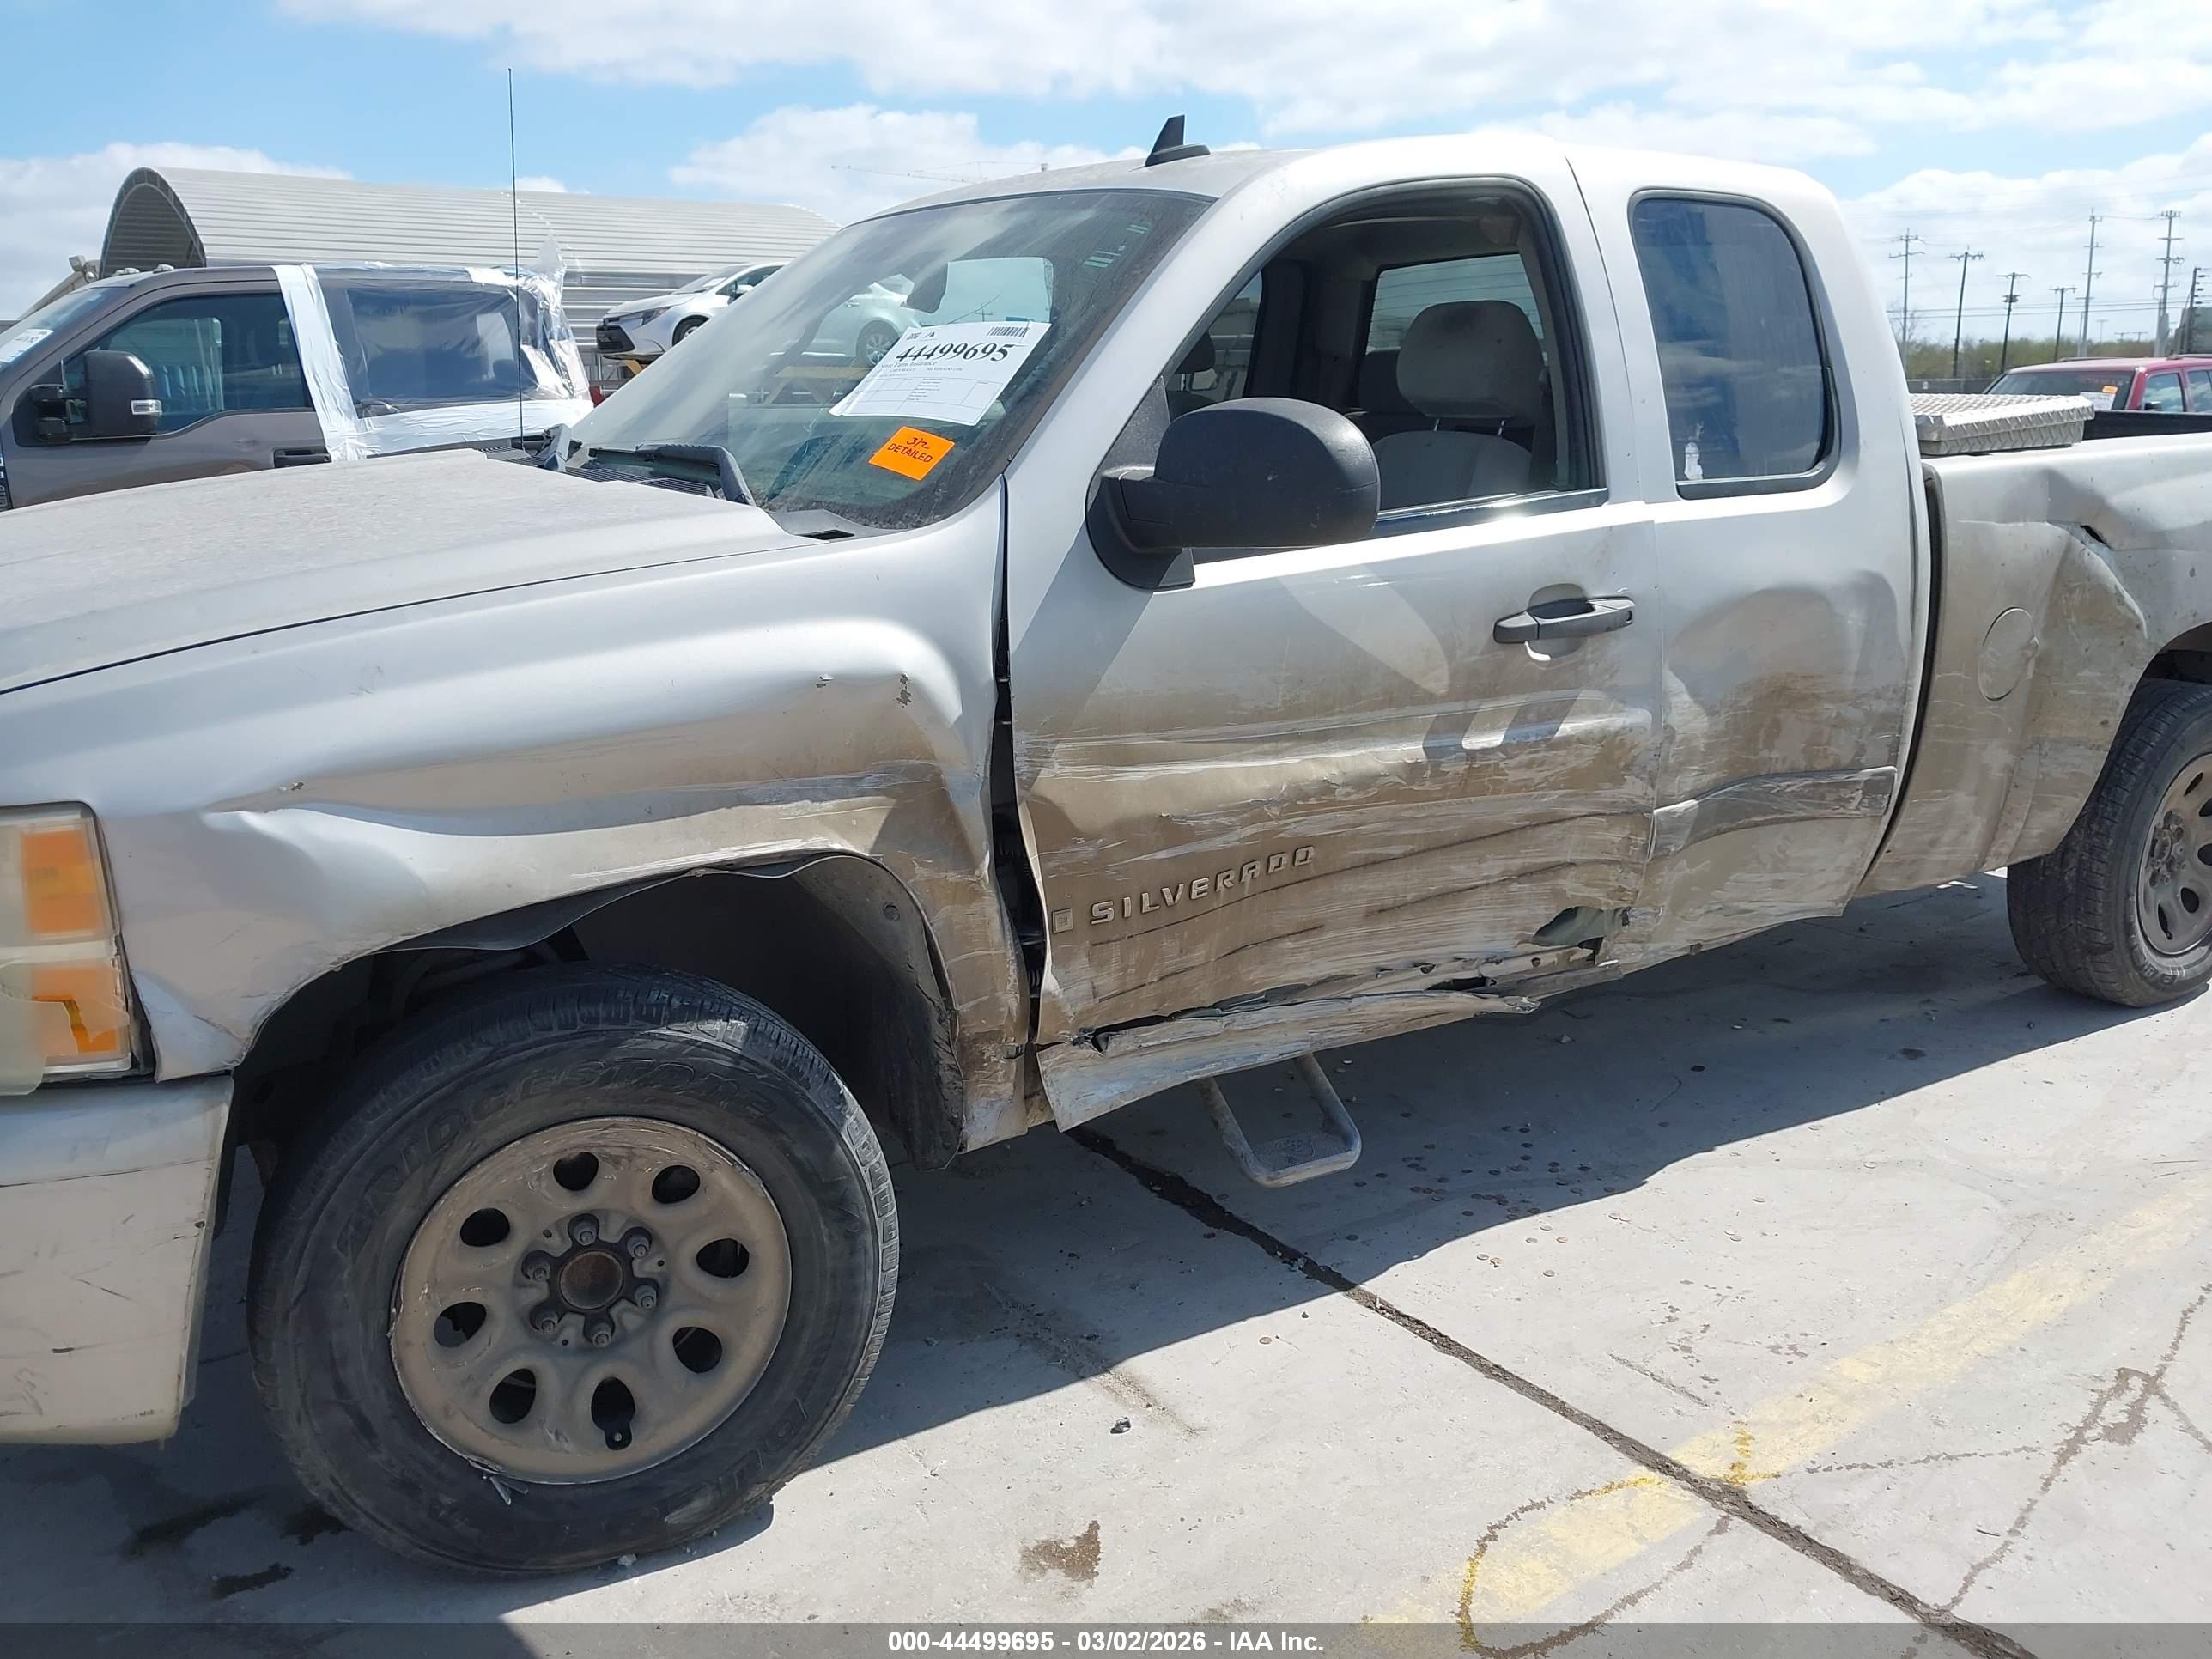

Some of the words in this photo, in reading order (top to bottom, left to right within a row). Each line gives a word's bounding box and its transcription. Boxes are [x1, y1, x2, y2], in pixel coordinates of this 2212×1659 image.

[896, 343, 1015, 362] 44499695
[907, 437, 930, 449] 3/2
[887, 443, 933, 463] DETAILED
[1090, 845, 1316, 925] SILVERADO
